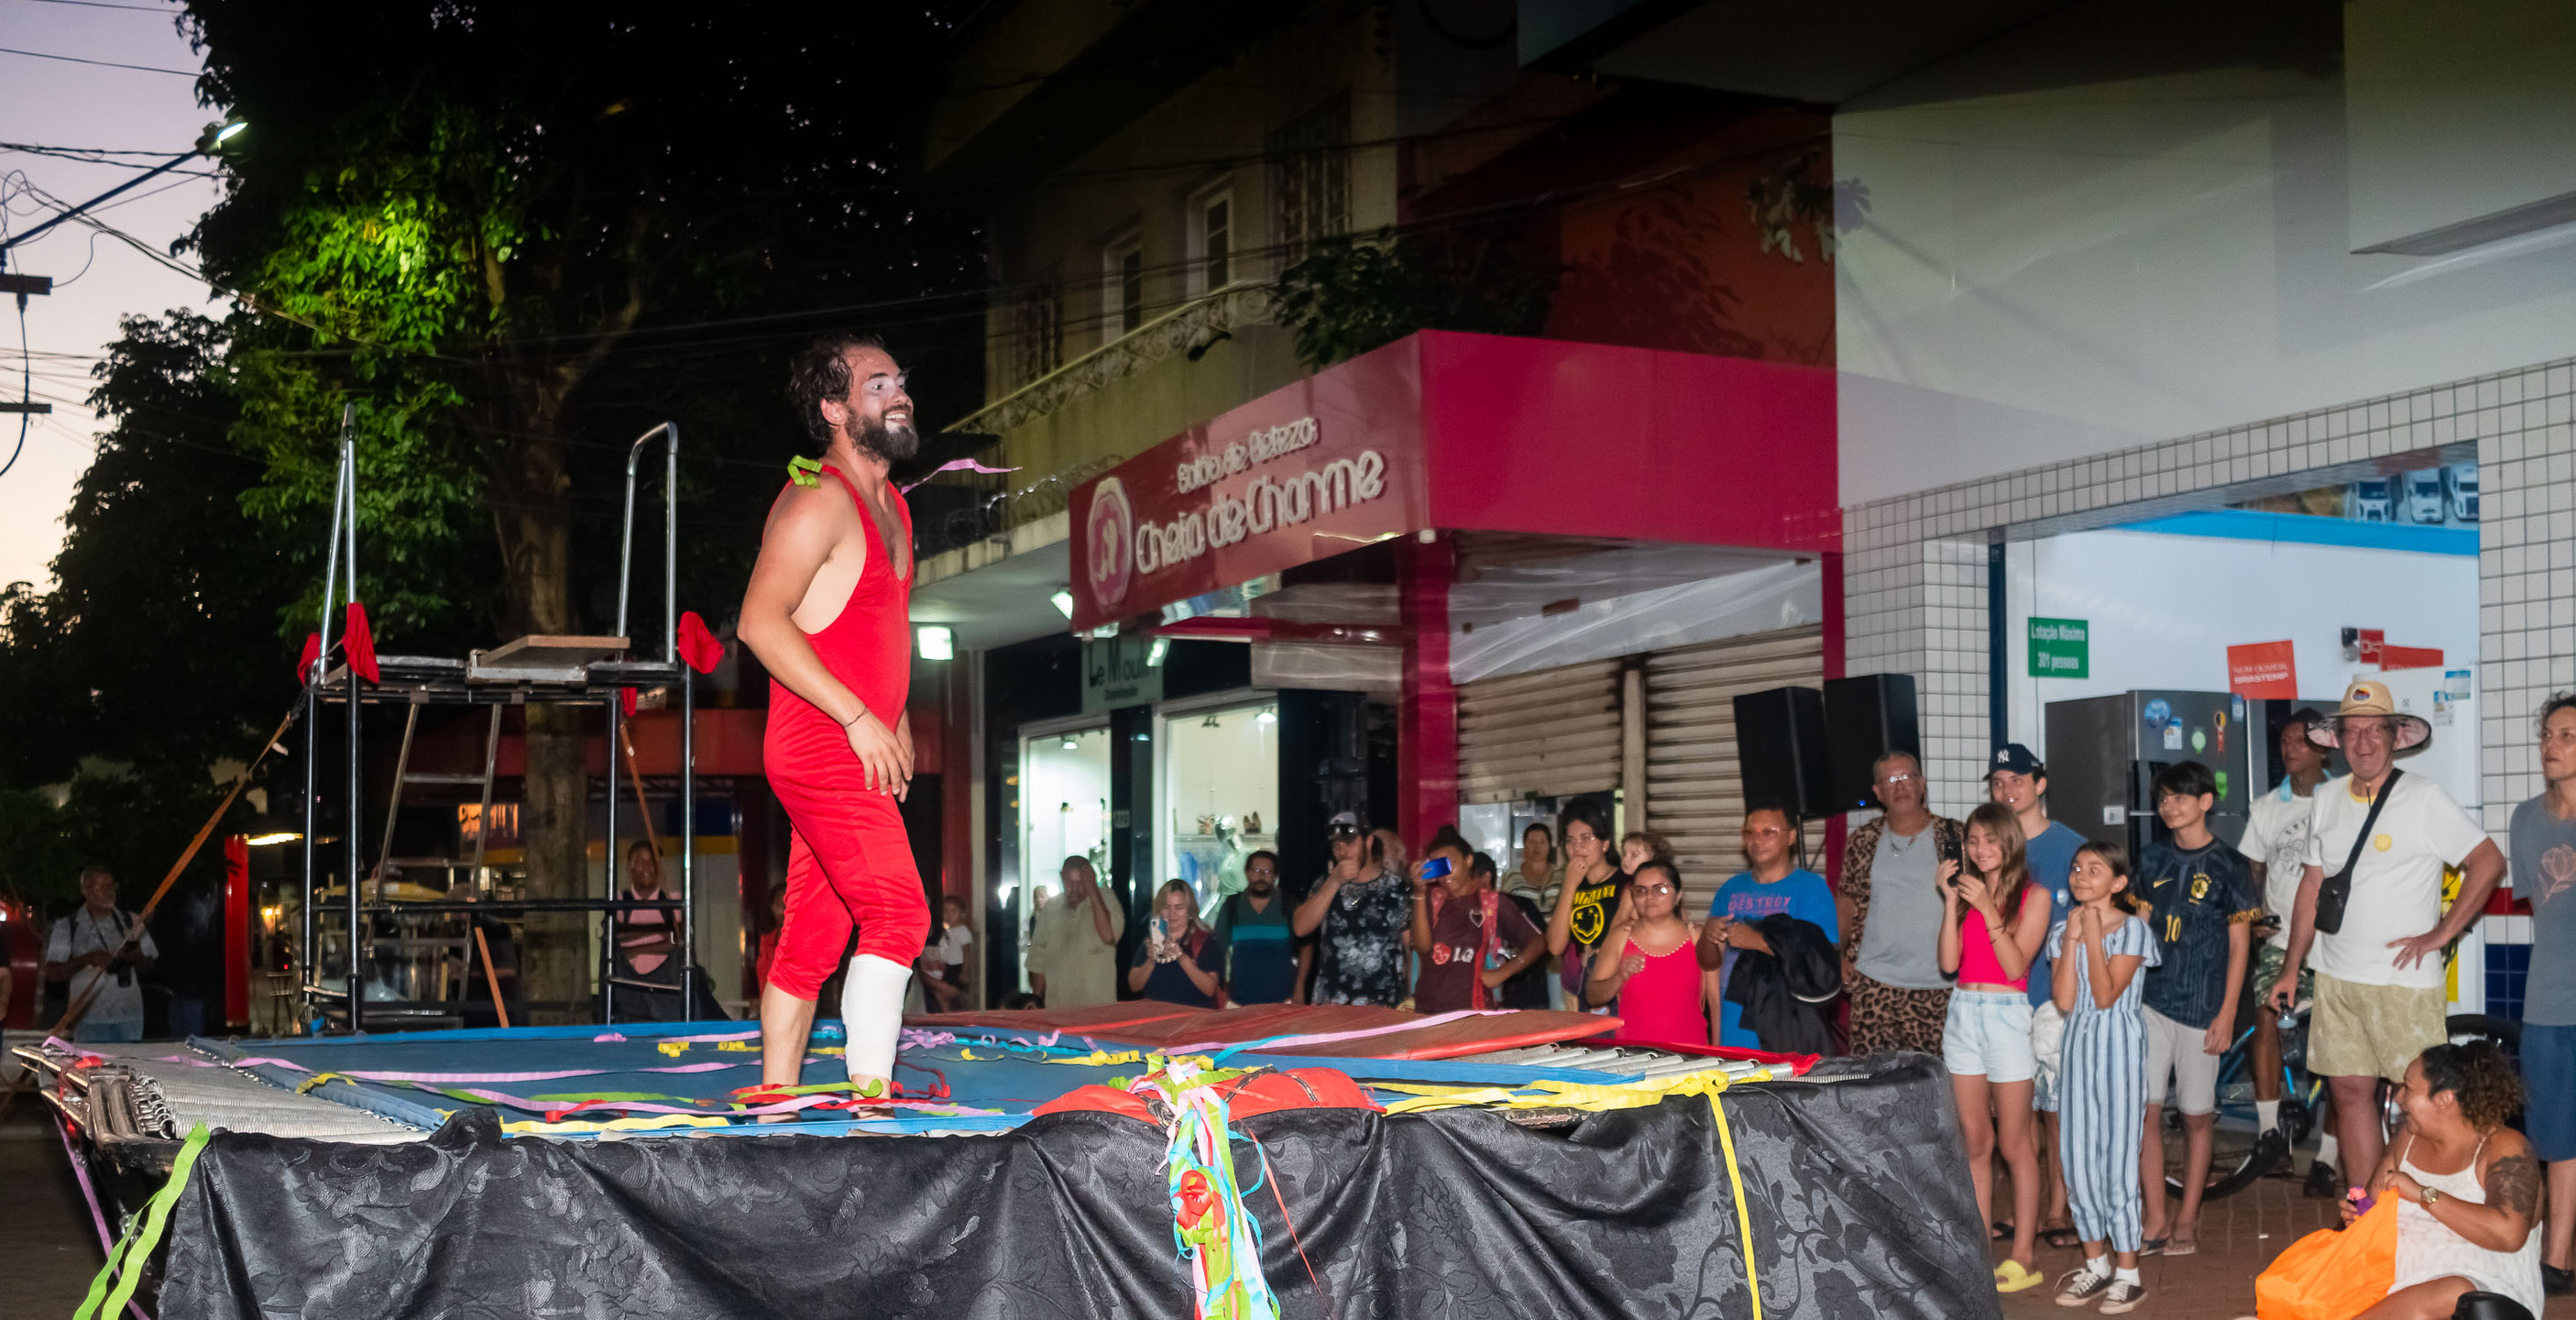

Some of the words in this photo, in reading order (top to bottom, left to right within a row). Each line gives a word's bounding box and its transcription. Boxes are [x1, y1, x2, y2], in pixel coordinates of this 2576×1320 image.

[1223, 442, 1248, 474] de
[1249, 417, 1318, 464] Beleza
[1137, 512, 1206, 575] Cheia
[1207, 493, 1247, 548] de
[1246, 450, 1384, 534] Charme
[2031, 623, 2057, 644] Lotação
[2058, 624, 2085, 642] Máxima
[2051, 655, 2079, 673] pessoas
[2233, 672, 2288, 685] BRASTEMP
[1727, 896, 1792, 911] DESTROY
[2165, 914, 2182, 942] 10
[1452, 946, 1474, 963] LG
